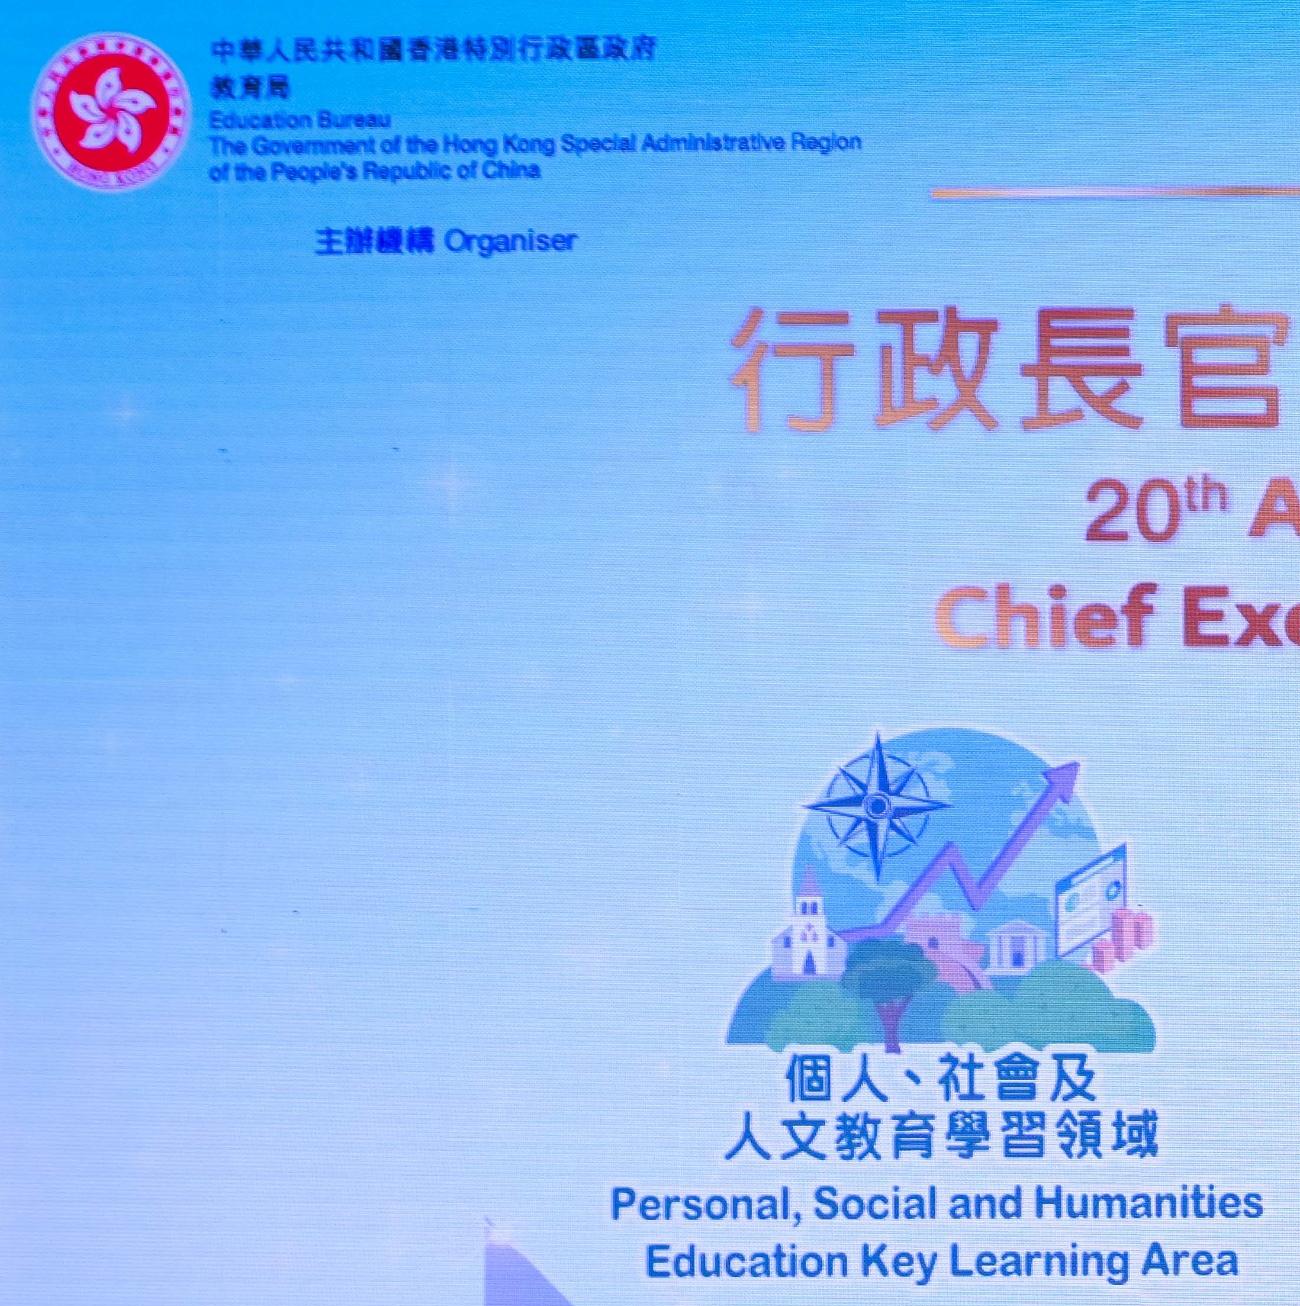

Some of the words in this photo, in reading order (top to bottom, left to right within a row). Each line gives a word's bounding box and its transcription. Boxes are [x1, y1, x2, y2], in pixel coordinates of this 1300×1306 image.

[211, 34, 657, 63] 中華人民共和國香港特別行政區政府
[211, 74, 290, 100] 教育局
[209, 110, 313, 129] Education
[317, 109, 391, 129] Bureau
[209, 136, 247, 156] The
[253, 135, 375, 155] Government
[380, 134, 401, 155] of
[406, 134, 437, 154] the
[443, 133, 498, 157] Hong
[503, 133, 556, 157] Kong
[560, 133, 637, 158] Special
[642, 132, 785, 152] Administrative
[792, 131, 863, 155] Region
[209, 161, 230, 182] of
[235, 162, 266, 181] the
[271, 161, 358, 184] People's
[363, 161, 452, 183] Republic
[457, 160, 479, 180] of
[483, 160, 541, 179] China
[315, 226, 435, 255] 主辦機構
[444, 227, 577, 259] Organiser
[1084, 472, 1229, 543] 20th
[933, 582, 1153, 650] Chief
[785, 1052, 1097, 1102] 個人、社會及
[724, 1109, 1159, 1160] 人文教育學習領域
[611, 1187, 801, 1227] Personal,
[814, 1185, 936, 1219] Social
[949, 1185, 1021, 1219] and
[1034, 1183, 1264, 1219] Humanities
[646, 1244, 848, 1278] Education
[861, 1243, 937, 1286] Key
[950, 1242, 1129, 1285] Learning
[1141, 1242, 1239, 1277] Area
